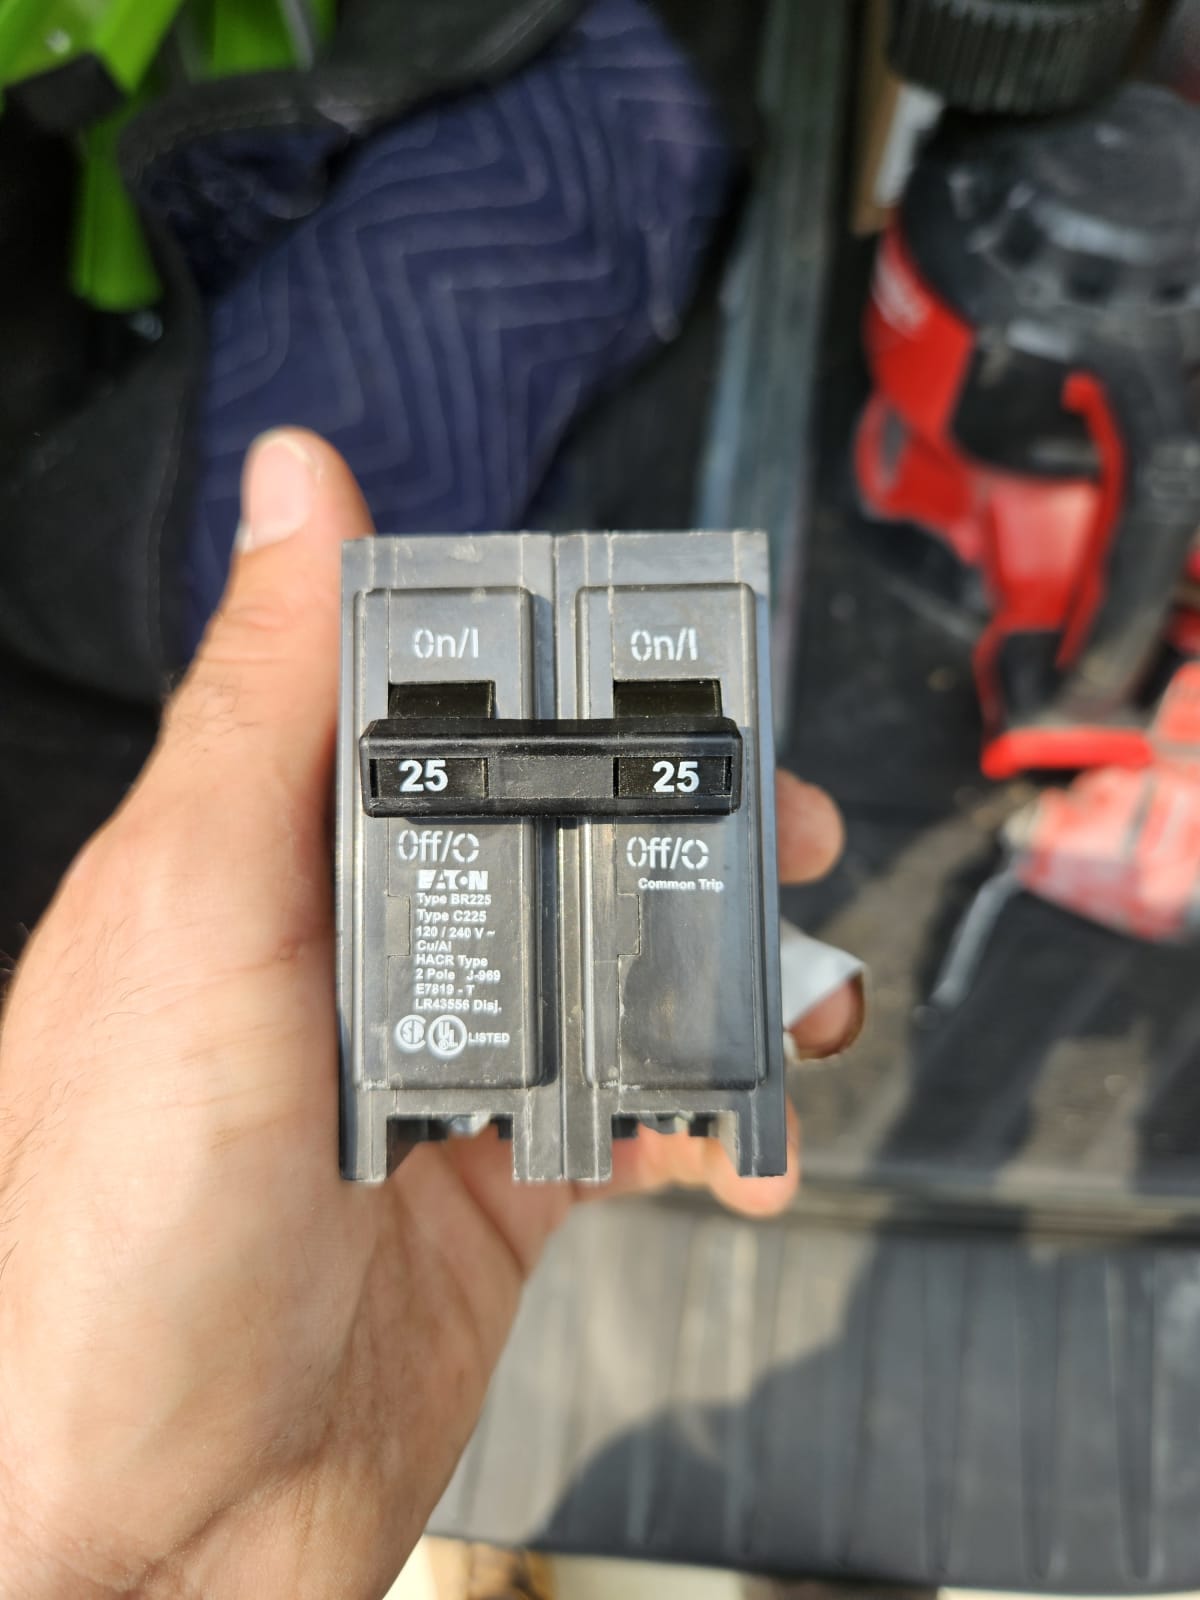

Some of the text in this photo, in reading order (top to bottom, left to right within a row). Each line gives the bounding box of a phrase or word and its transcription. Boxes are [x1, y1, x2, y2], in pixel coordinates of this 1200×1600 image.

[399, 759, 449, 793] 25
[652, 760, 700, 793] 25
[418, 869, 489, 891] EATON
[638, 877, 725, 893] Common Trip
[416, 892, 492, 907] Type BR225
[416, 908, 487, 923] Type C225
[416, 926, 439, 938] 120
[449, 926, 472, 938] 240
[416, 954, 488, 969] HACR Type
[415, 967, 424, 981] 2
[426, 967, 456, 982] Pole
[468, 1032, 510, 1043] LISTED
